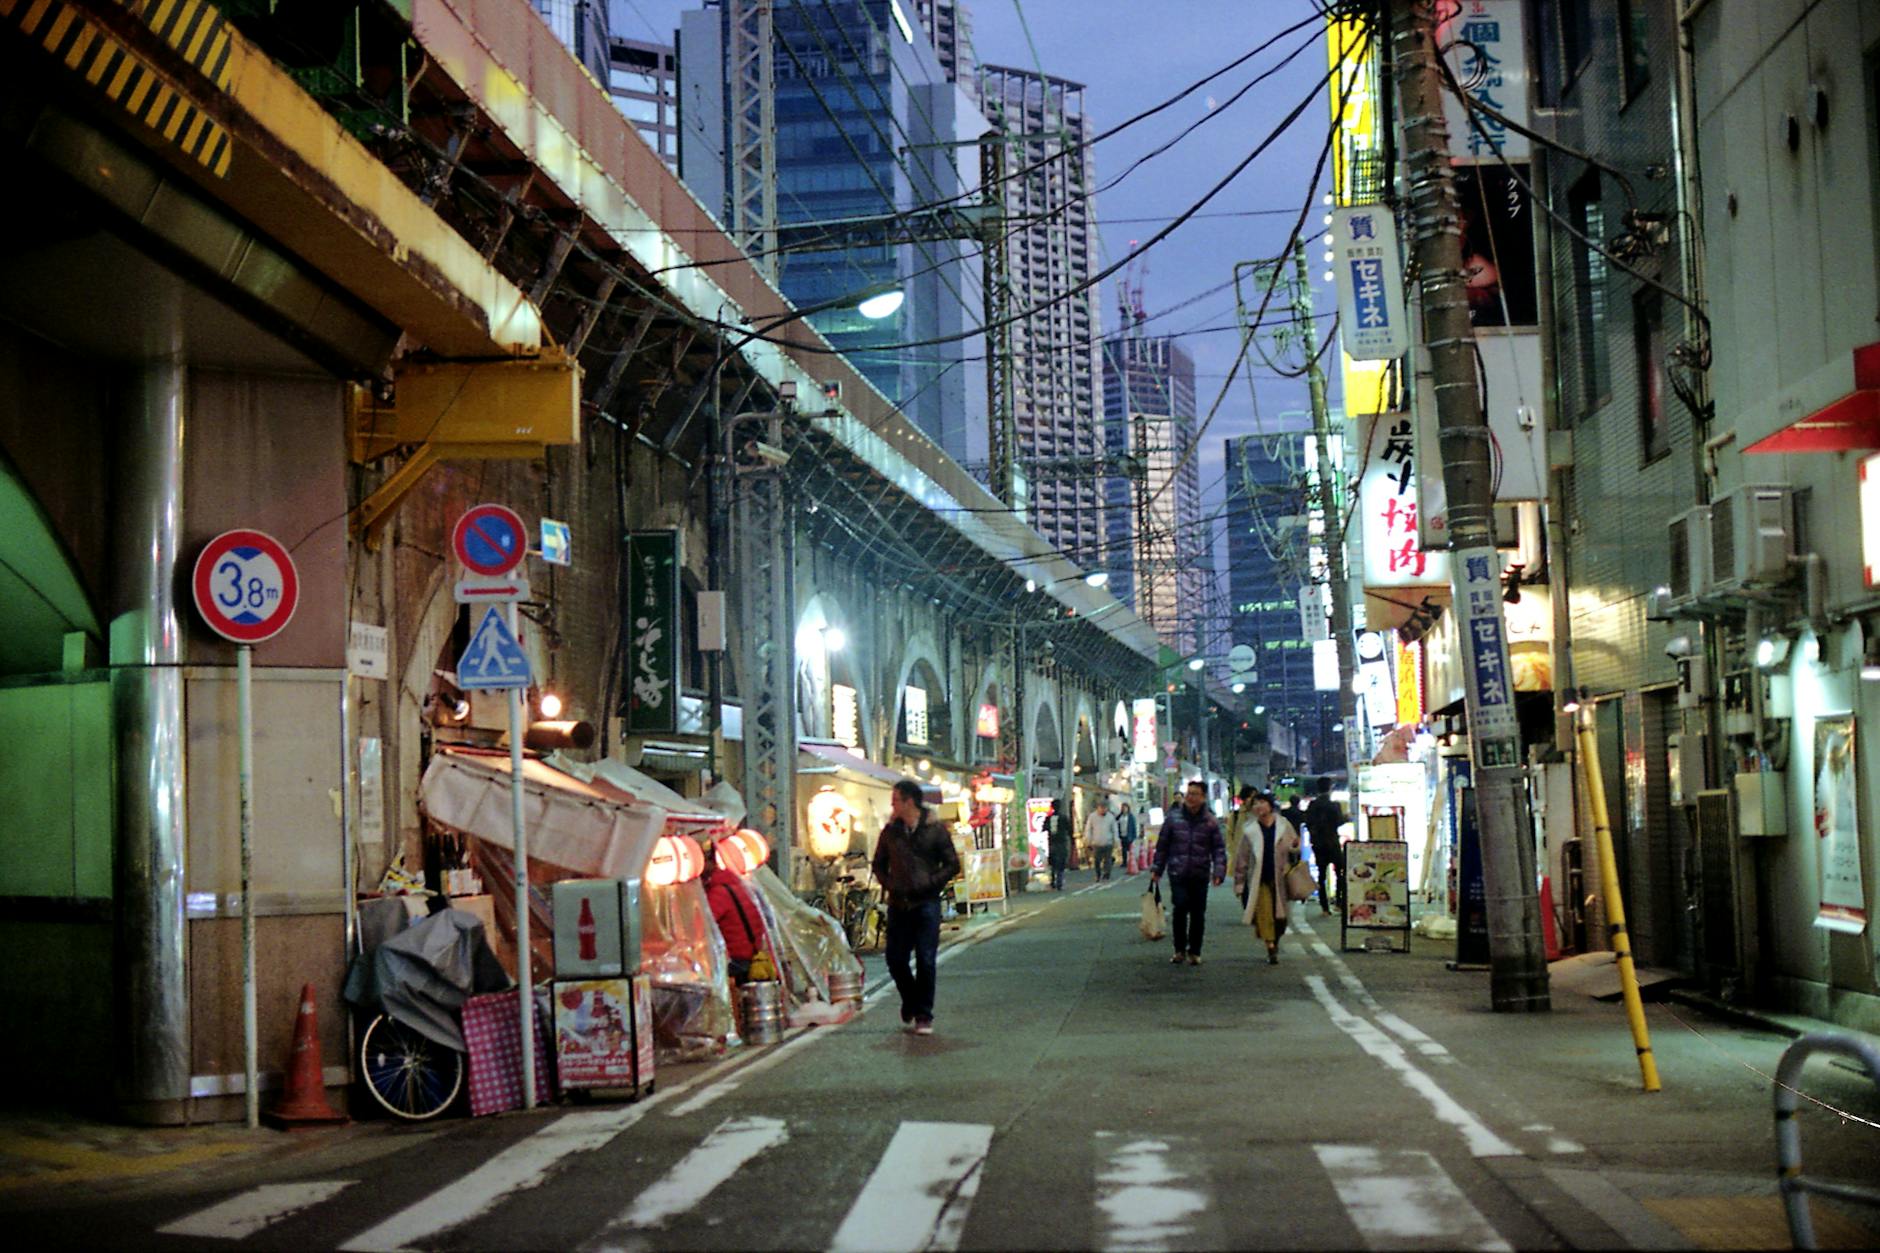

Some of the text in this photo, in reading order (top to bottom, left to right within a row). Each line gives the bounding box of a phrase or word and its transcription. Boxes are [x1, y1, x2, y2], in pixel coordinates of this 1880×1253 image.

[1349, 215, 1376, 241] 質
[1356, 260, 1383, 328] セキネ
[219, 561, 278, 608] 3.8m
[1466, 555, 1491, 583] 質
[1475, 623, 1504, 704] セキネ
